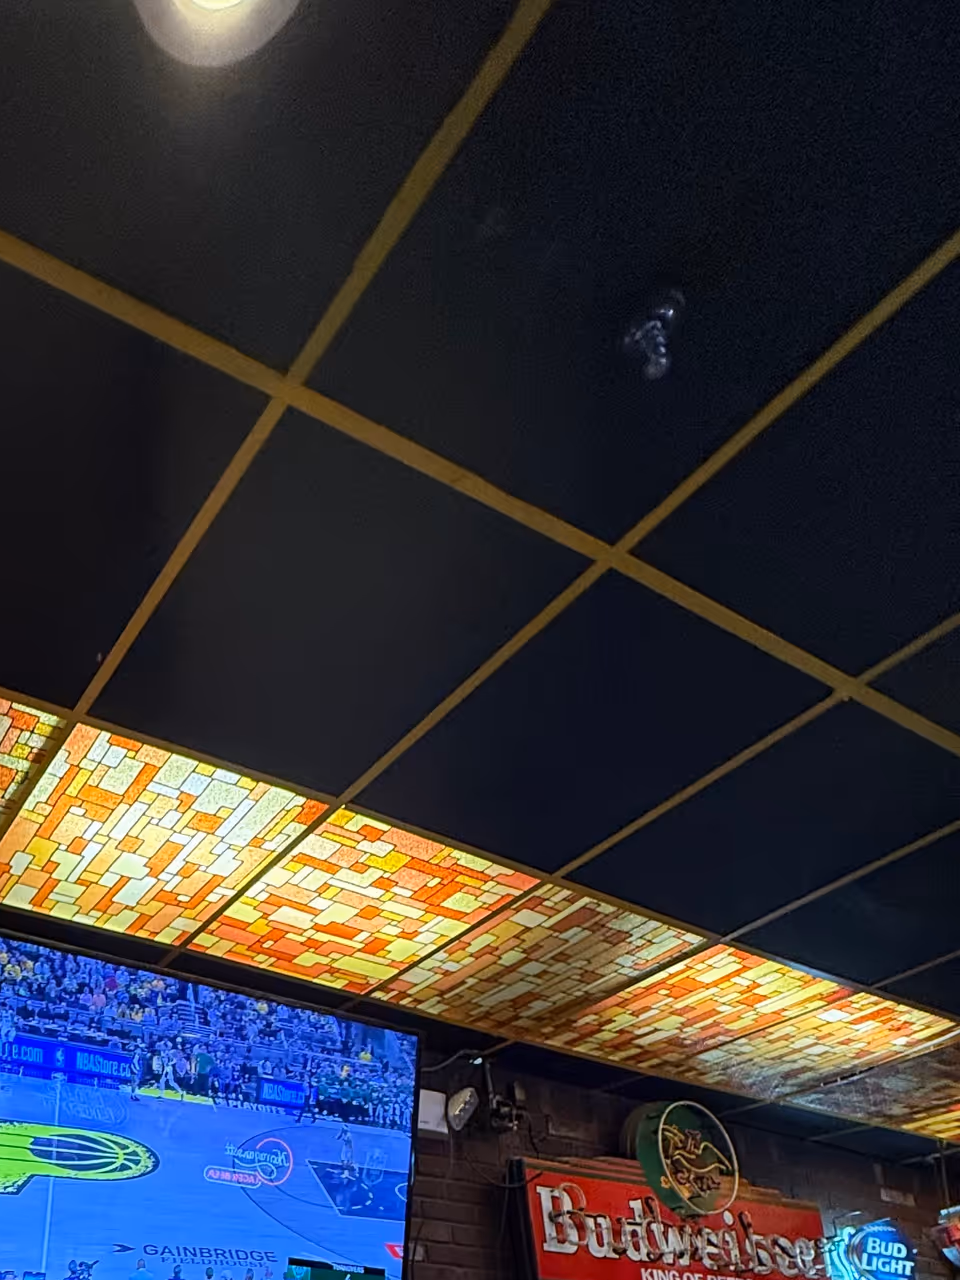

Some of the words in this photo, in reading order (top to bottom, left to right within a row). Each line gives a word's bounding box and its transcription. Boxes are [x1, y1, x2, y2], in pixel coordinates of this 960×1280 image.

[536, 1182, 829, 1280] Budweiser
[143, 1244, 278, 1263] GAINBRIDGE
[866, 1236, 908, 1259] BUD
[861, 1252, 915, 1276] LIGHT
